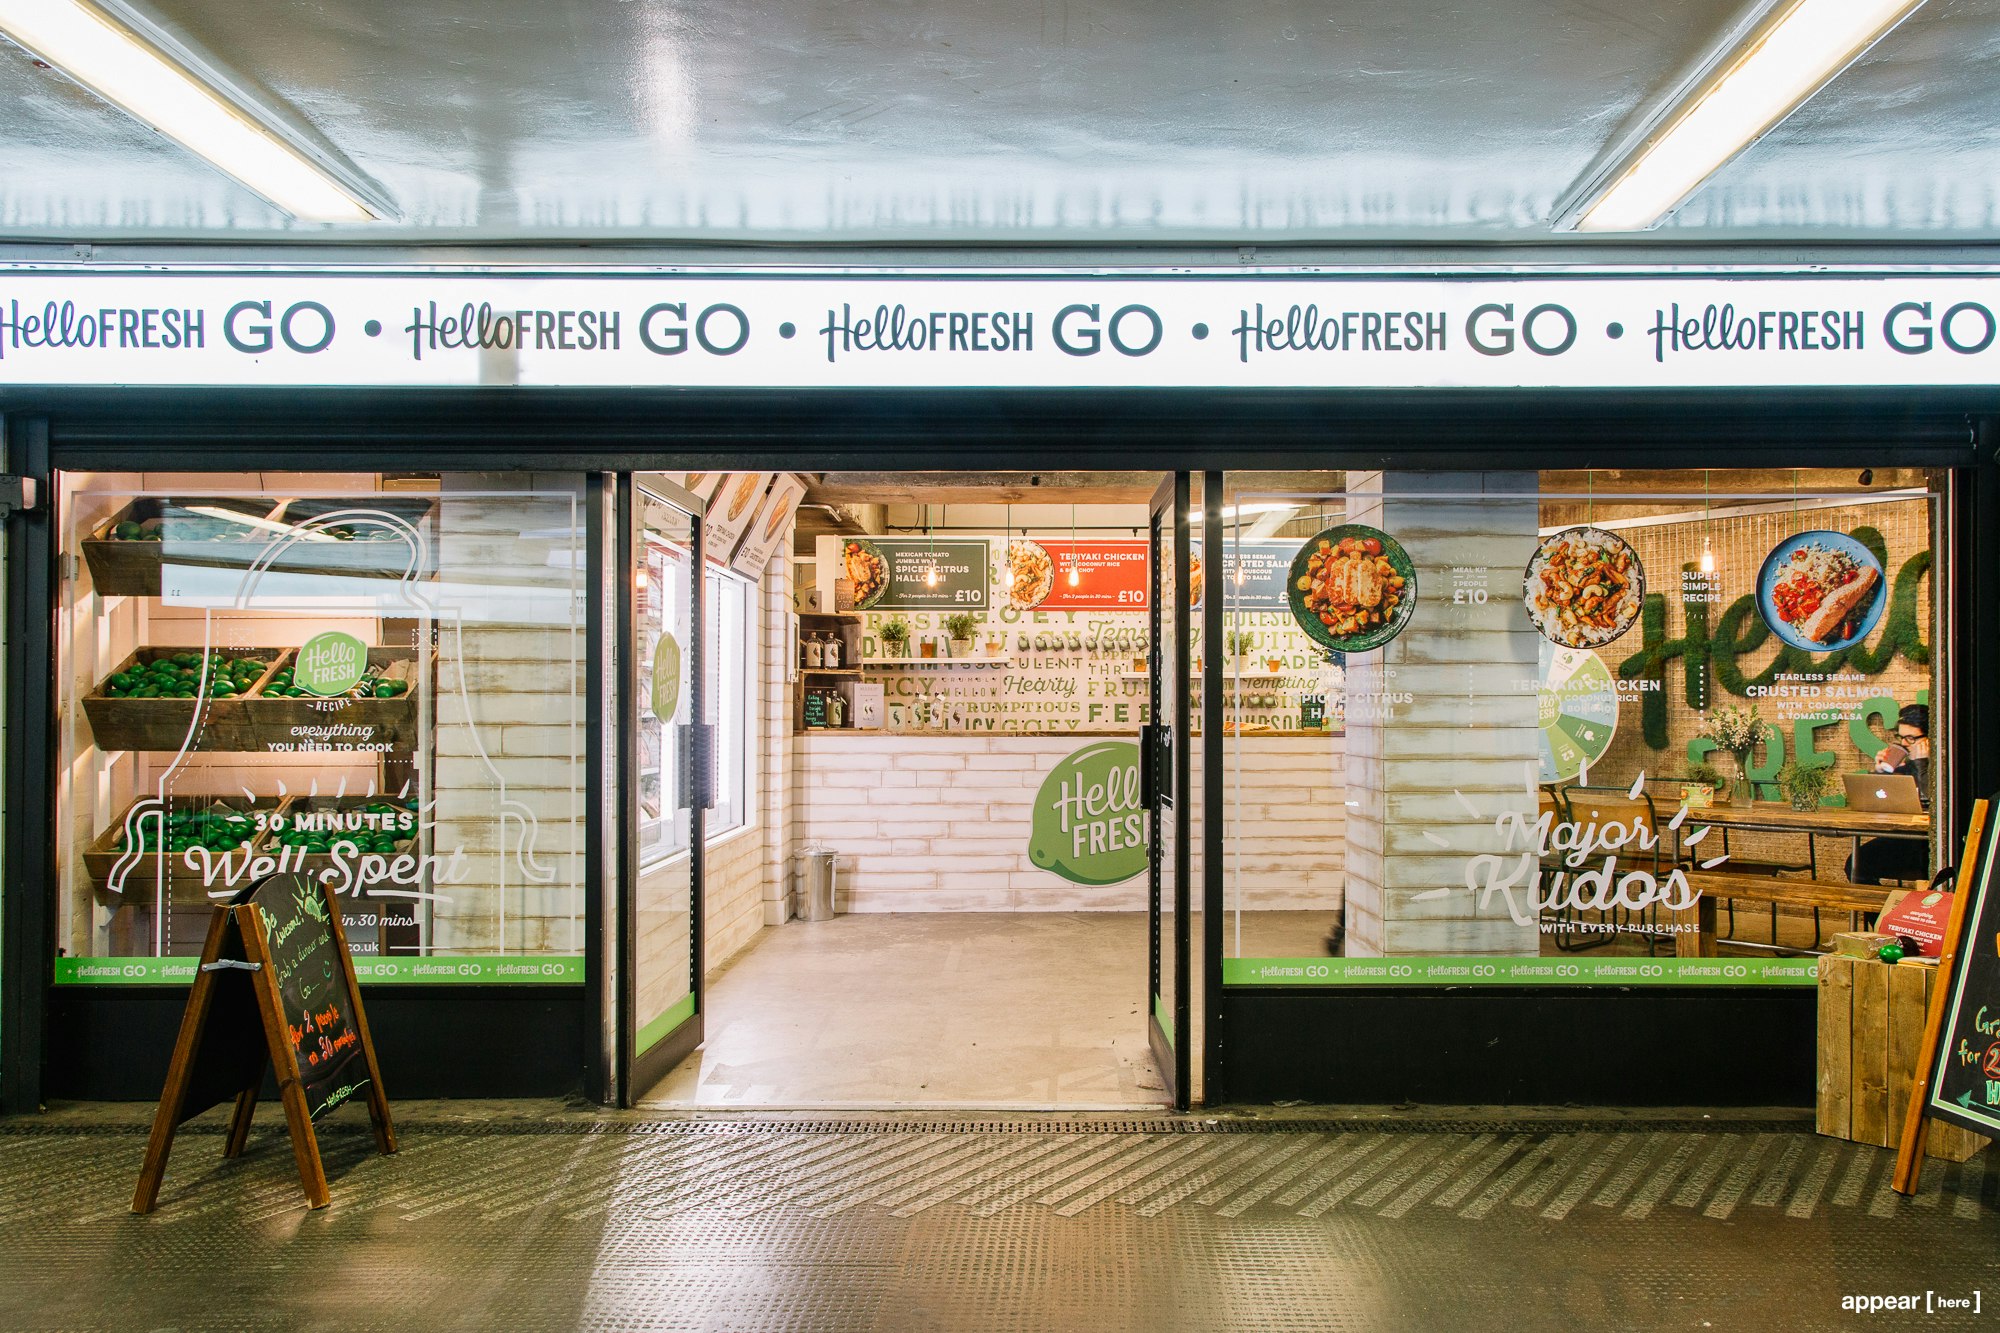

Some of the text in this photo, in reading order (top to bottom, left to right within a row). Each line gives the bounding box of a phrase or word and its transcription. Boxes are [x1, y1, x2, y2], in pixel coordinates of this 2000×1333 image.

[223, 300, 335, 354] GO
[639, 302, 750, 355] GO
[1051, 303, 1163, 356] GO
[1465, 303, 1577, 356] GO
[1882, 302, 1997, 355] GO
[896, 574, 946, 582] HALLOMI
[1682, 571, 1720, 581] SUPER
[1682, 582, 1721, 591] SIMPLE
[955, 590, 981, 602] £10
[1118, 590, 1144, 603] £10
[1453, 589, 1488, 605] £10
[1683, 593, 1721, 602] RECIPE
[305, 642, 355, 672] Hello
[313, 663, 355, 684] FRESH
[656, 647, 677, 691] Hello
[943, 687, 998, 697] MELLOW
[1003, 675, 1078, 698] Hearty
[1746, 685, 1893, 698] CRUSTED SALMON
[316, 699, 352, 712] RECIPE
[1354, 693, 1413, 704] CITRUS
[291, 724, 374, 741] everything
[268, 743, 394, 752] YOU NEED TO COOK
[1052, 765, 1139, 833] Hell
[255, 813, 413, 832] 30 MINUTES
[1495, 810, 1660, 867] Major
[319, 840, 471, 898] Spent
[1465, 852, 1703, 927] Kudos
[260, 907, 277, 944] Be
[358, 914, 376, 926] 30
[379, 914, 415, 927] mins
[1540, 923, 1701, 933] WITH EVERY PURCHASE
[1888, 924, 1914, 934] TERIYAKI
[1915, 930, 1943, 941] CHICKEN
[347, 942, 379, 952] co.uk
[123, 965, 147, 977] GO
[374, 964, 398, 976] GO
[458, 964, 481, 975] GO
[541, 963, 564, 975] GO
[292, 959, 298, 968] a
[1306, 965, 1329, 977] GO
[1389, 965, 1412, 977] GO
[1472, 965, 1495, 977] GO
[1556, 965, 1579, 977] GO
[1639, 965, 1662, 977] GO
[1723, 965, 1746, 977] GO
[1807, 965, 1818, 977] G
[318, 1036, 333, 1060] 30
[1958, 1039, 1981, 1066] for
